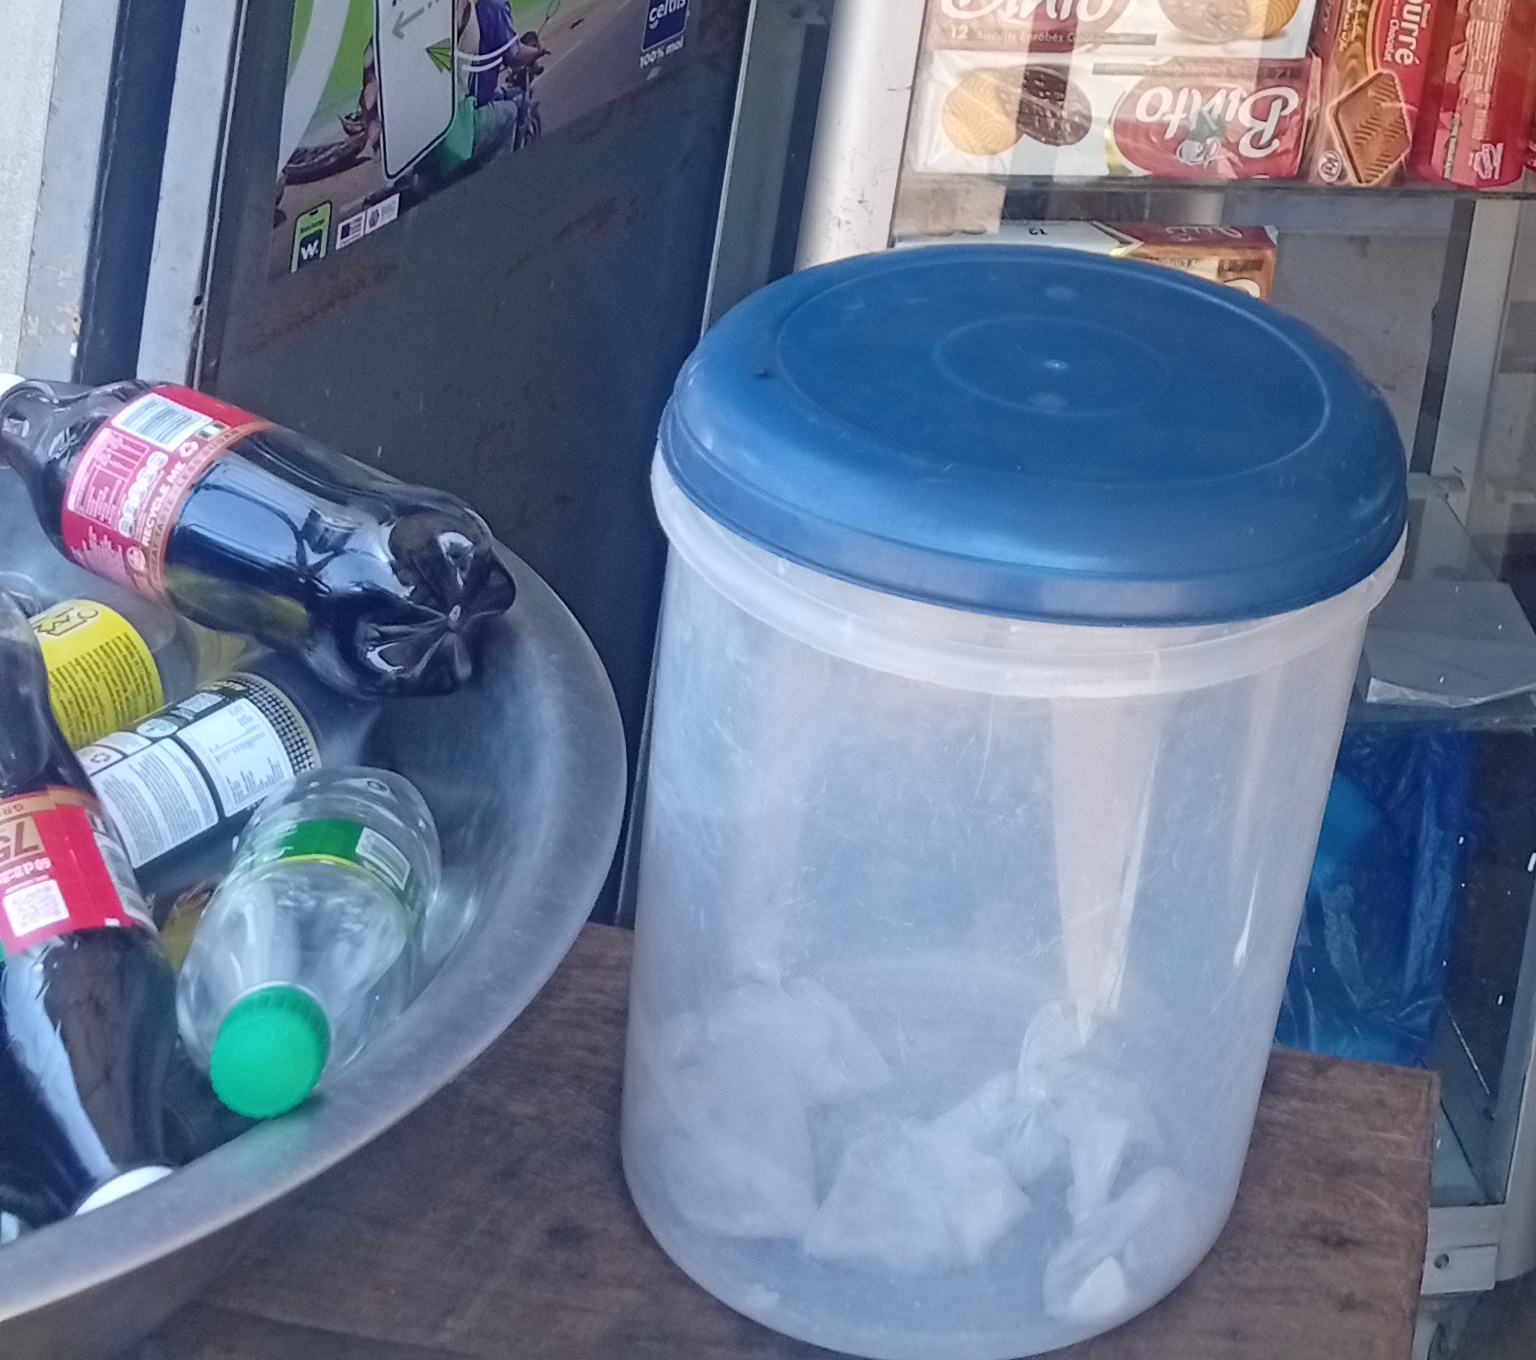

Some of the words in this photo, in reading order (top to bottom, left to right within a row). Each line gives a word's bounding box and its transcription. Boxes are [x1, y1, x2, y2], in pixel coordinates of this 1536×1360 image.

[950, 26, 969, 40] 12
[1383, 18, 1399, 62] Chocolat
[639, 48, 665, 68] 100%
[1135, 85, 1302, 159] Binto
[141, 480, 171, 548] RECYCLE
[166, 461, 187, 483] ME
